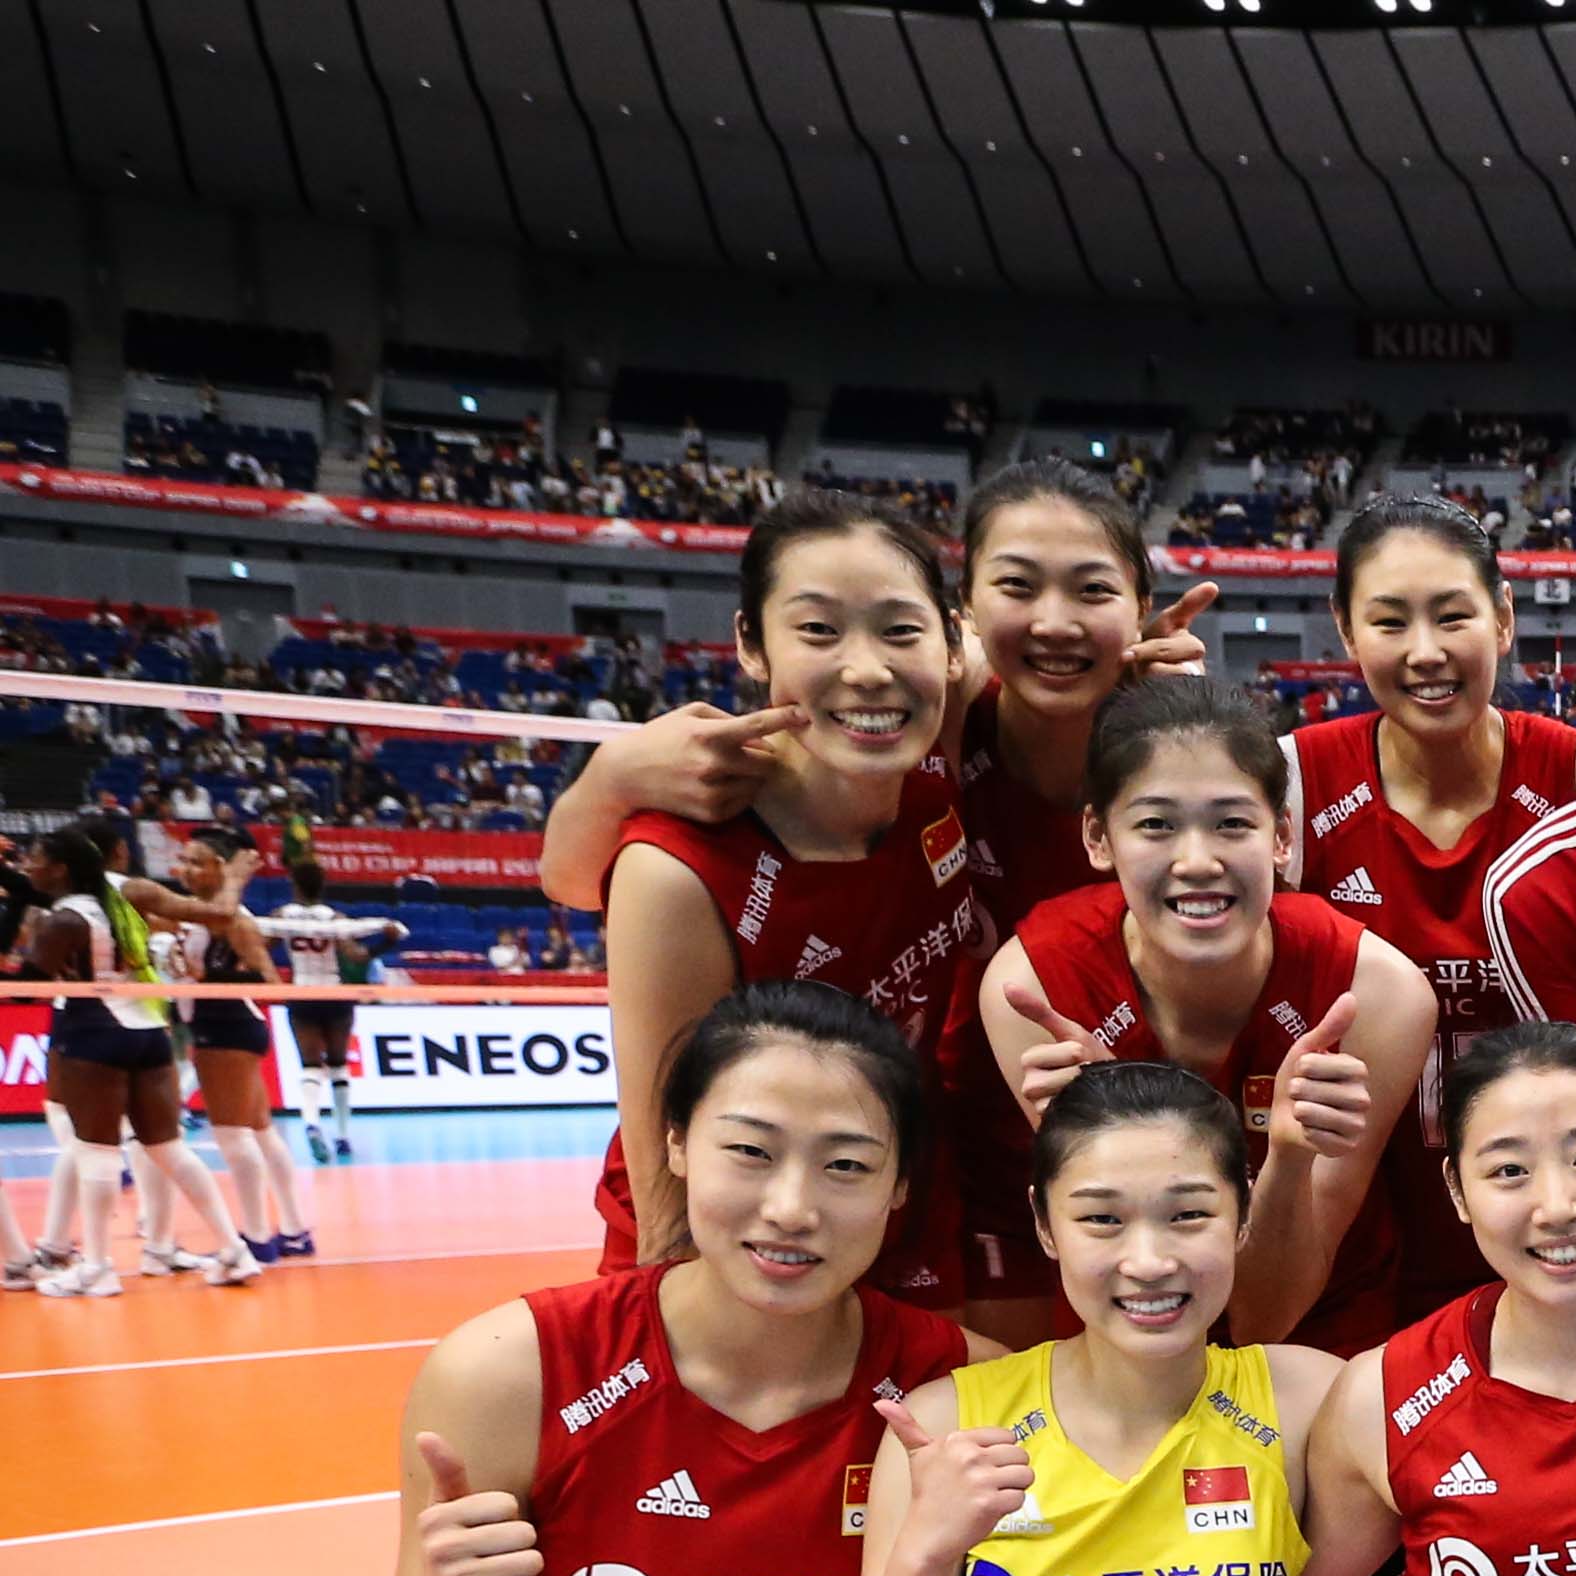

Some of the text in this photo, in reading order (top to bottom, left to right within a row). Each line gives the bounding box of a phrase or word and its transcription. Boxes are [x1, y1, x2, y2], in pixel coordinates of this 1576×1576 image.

[1373, 324, 1493, 357] KIRIN
[1311, 781, 1373, 839] 腾讯体育
[737, 851, 783, 945] 腾讯体育
[1330, 886, 1383, 906] adidas
[374, 1033, 611, 1077] ENEOS
[561, 1358, 653, 1434] 腾讯体育
[1392, 1353, 1472, 1436] 腾讯体育
[1208, 1390, 1281, 1447] 腾讯体育
[637, 1498, 712, 1520] adidas
[1433, 1478, 1498, 1498] adidas
[1194, 1509, 1248, 1528] CHN
